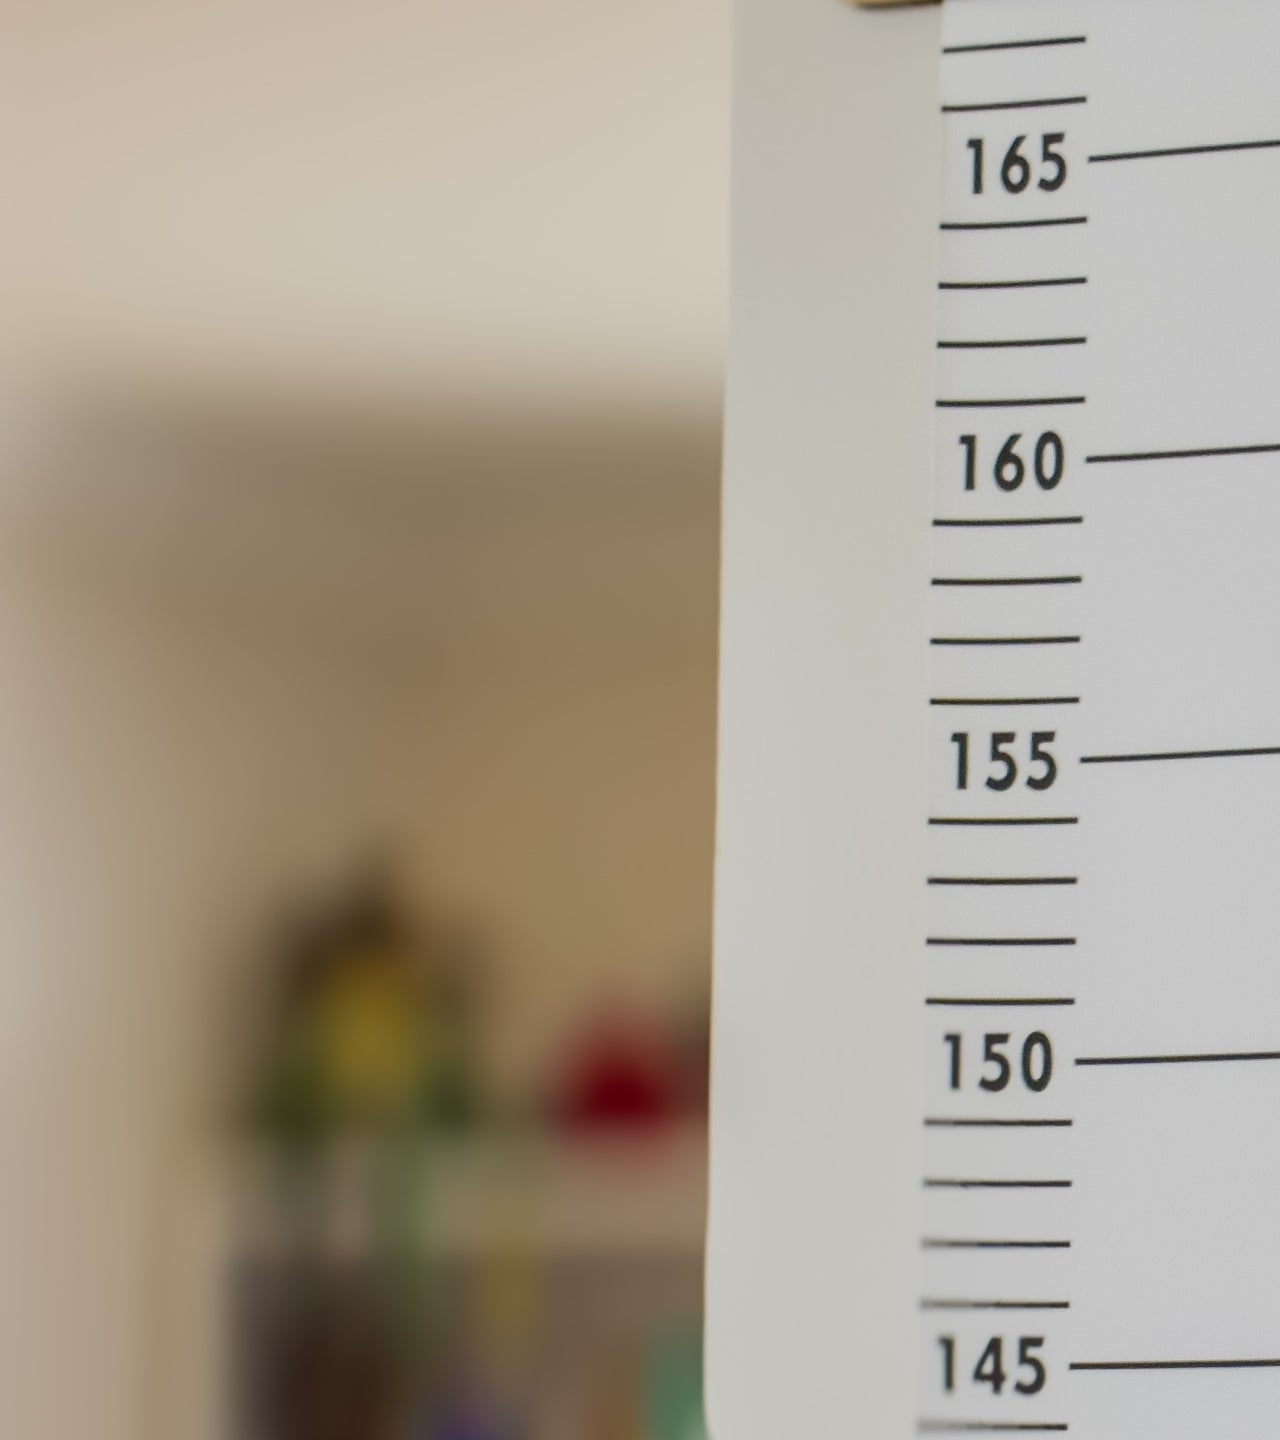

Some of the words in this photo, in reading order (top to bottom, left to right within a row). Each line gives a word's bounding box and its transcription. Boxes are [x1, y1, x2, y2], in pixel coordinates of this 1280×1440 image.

[965, 131, 1068, 196] 165
[957, 429, 1066, 492] 160
[949, 729, 1059, 792] 155
[940, 1030, 1054, 1093] 150
[936, 1335, 1048, 1397] 145
